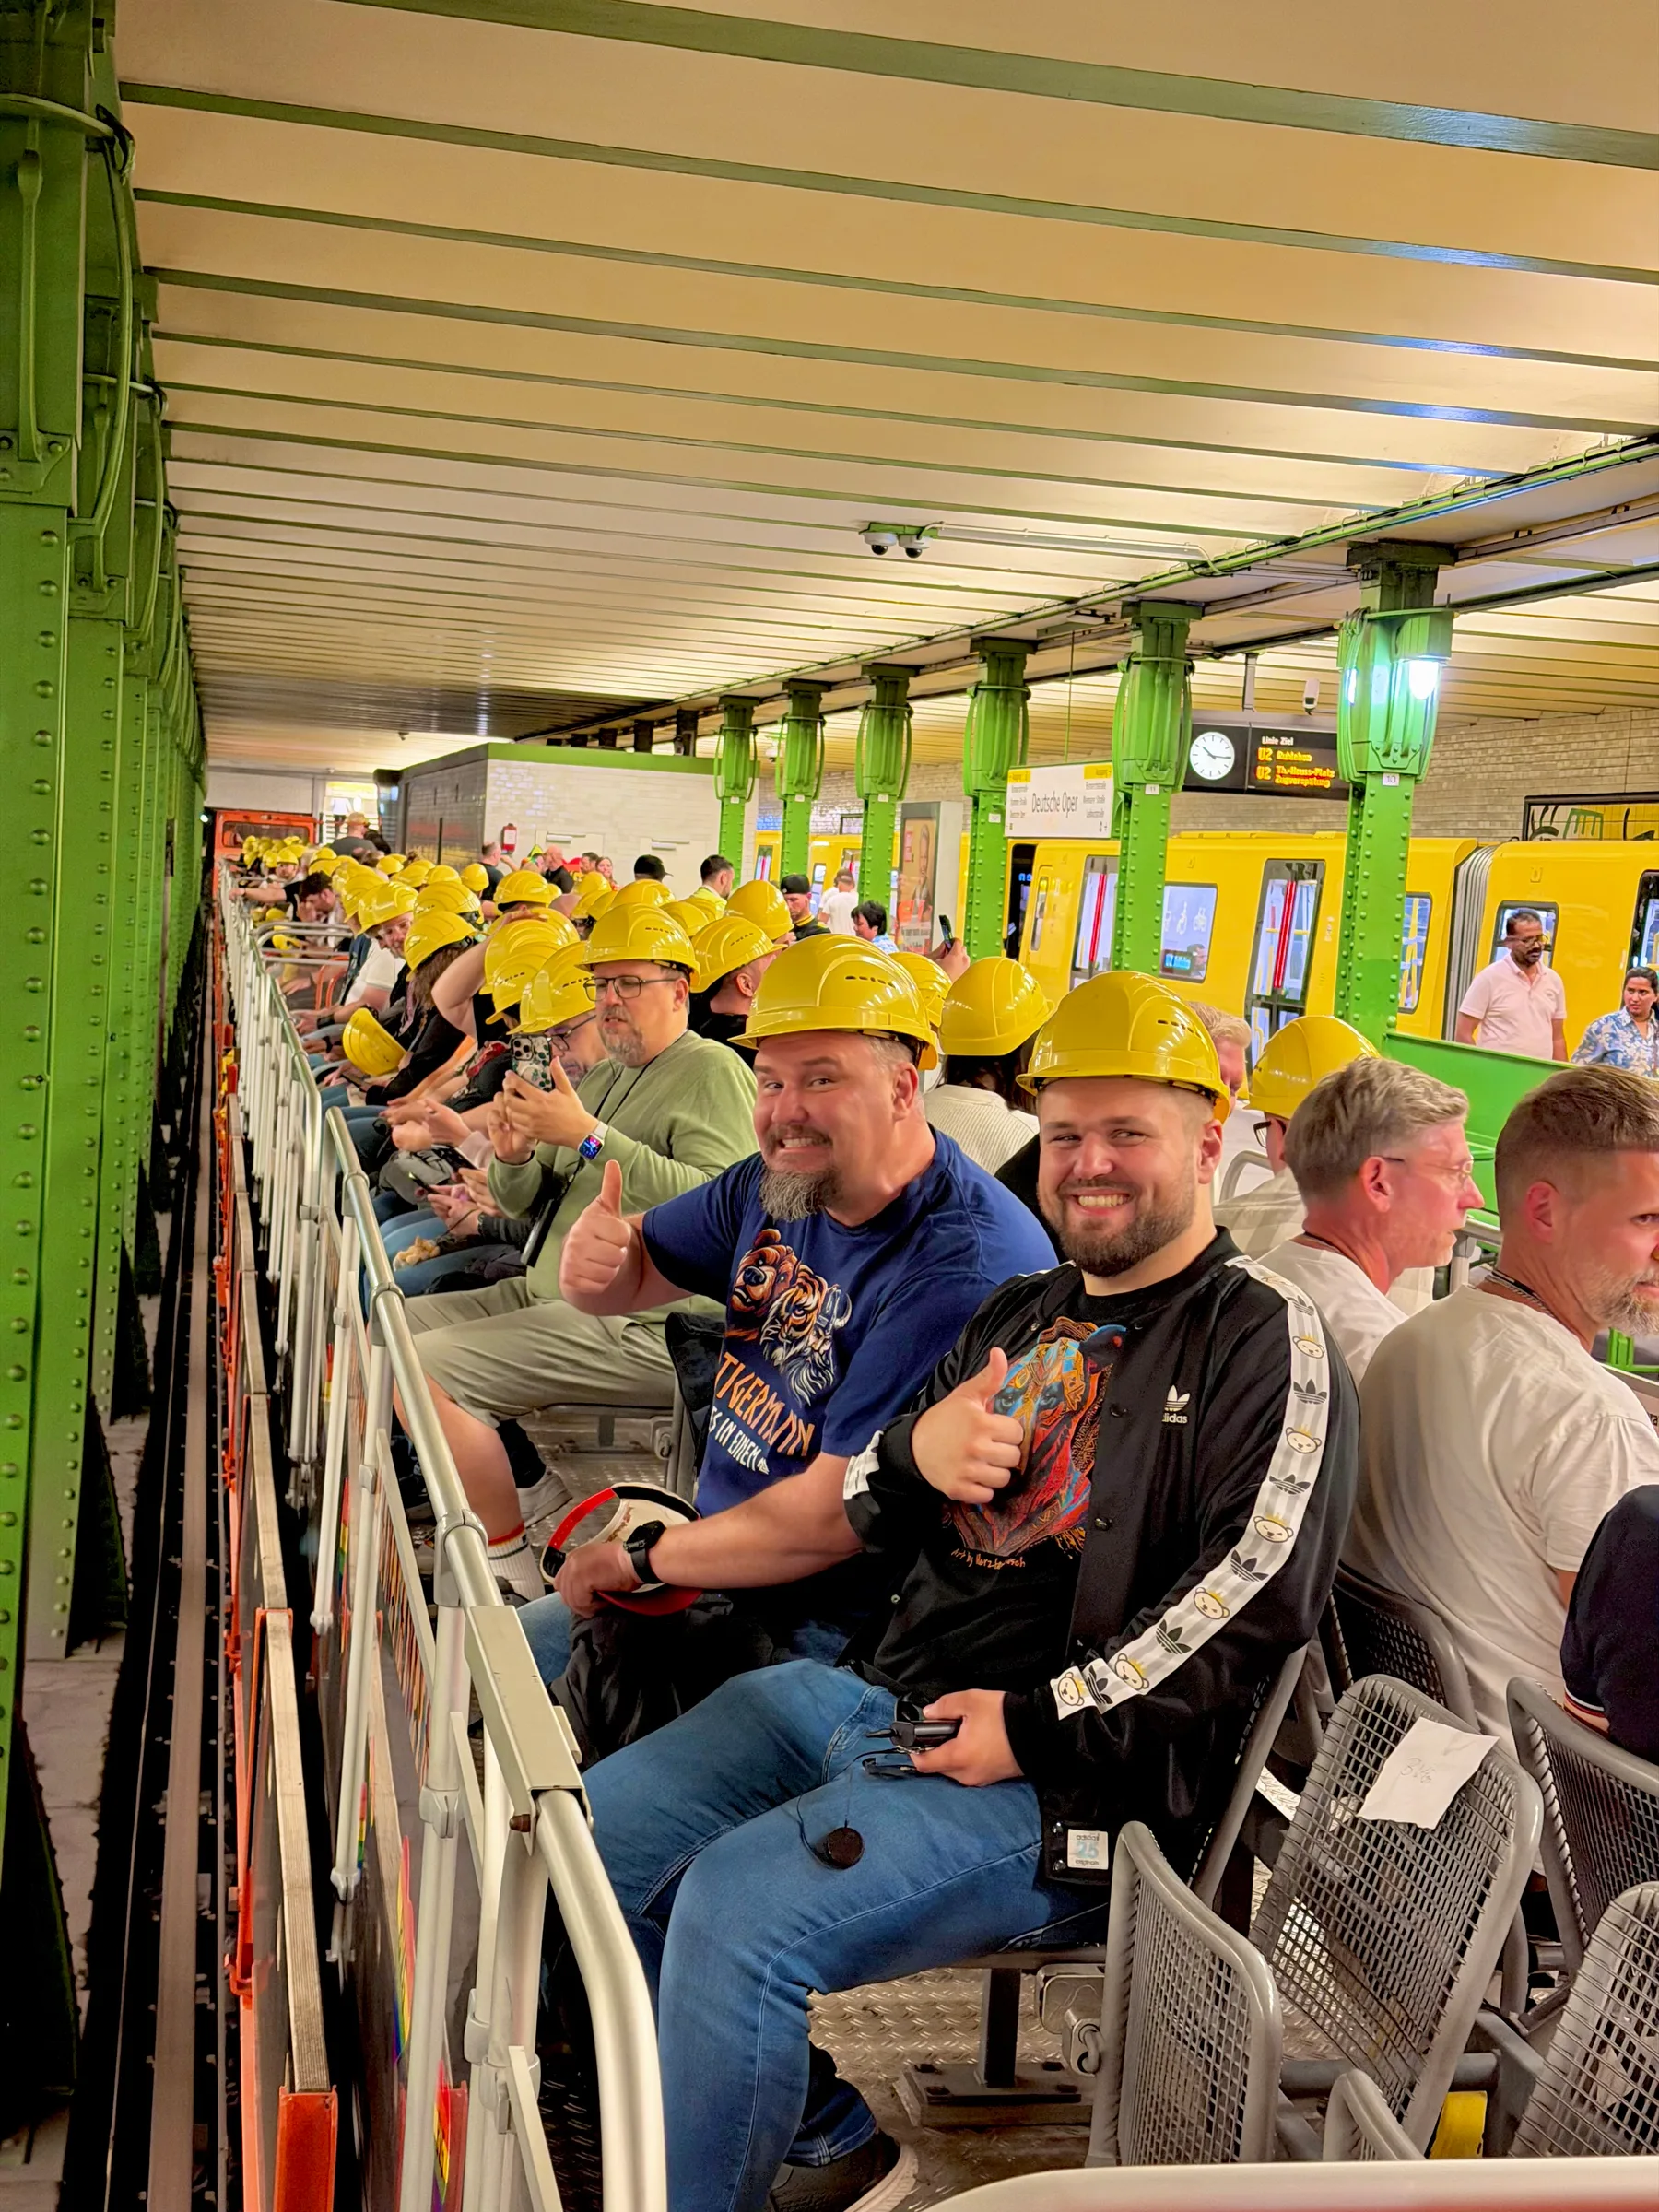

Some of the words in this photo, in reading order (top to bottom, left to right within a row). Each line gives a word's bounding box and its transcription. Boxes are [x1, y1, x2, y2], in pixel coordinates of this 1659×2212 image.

[1261, 735, 1279, 746] Linie
[1280, 736, 1294, 747] Ziel
[1257, 747, 1274, 762] U2
[1255, 765, 1272, 781] U2
[1031, 790, 1061, 813] Deutsche
[1062, 791, 1078, 818] Oper
[715, 1418, 737, 1448] IN
